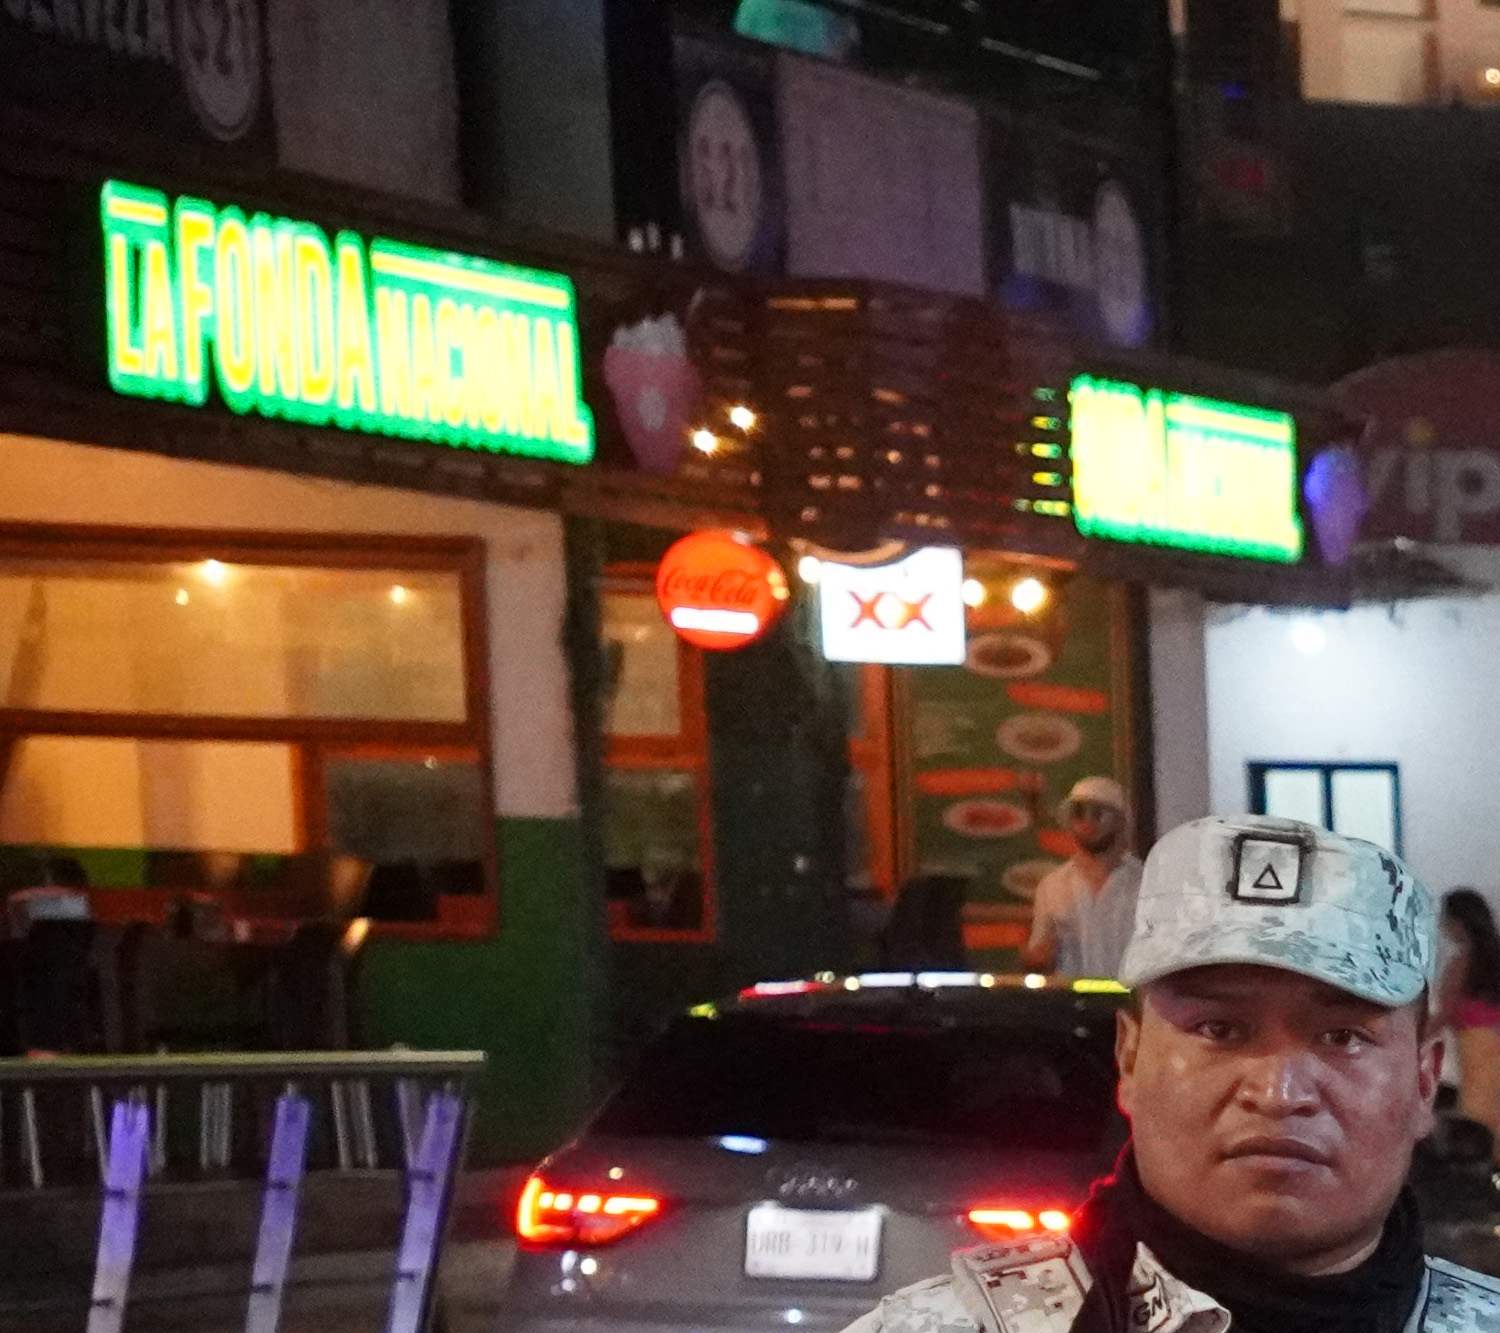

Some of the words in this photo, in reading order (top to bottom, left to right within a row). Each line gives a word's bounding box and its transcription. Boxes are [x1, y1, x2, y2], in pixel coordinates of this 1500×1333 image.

[110, 233, 177, 380] LA
[179, 212, 376, 415] FONDA
[374, 285, 590, 447] NACIONAL
